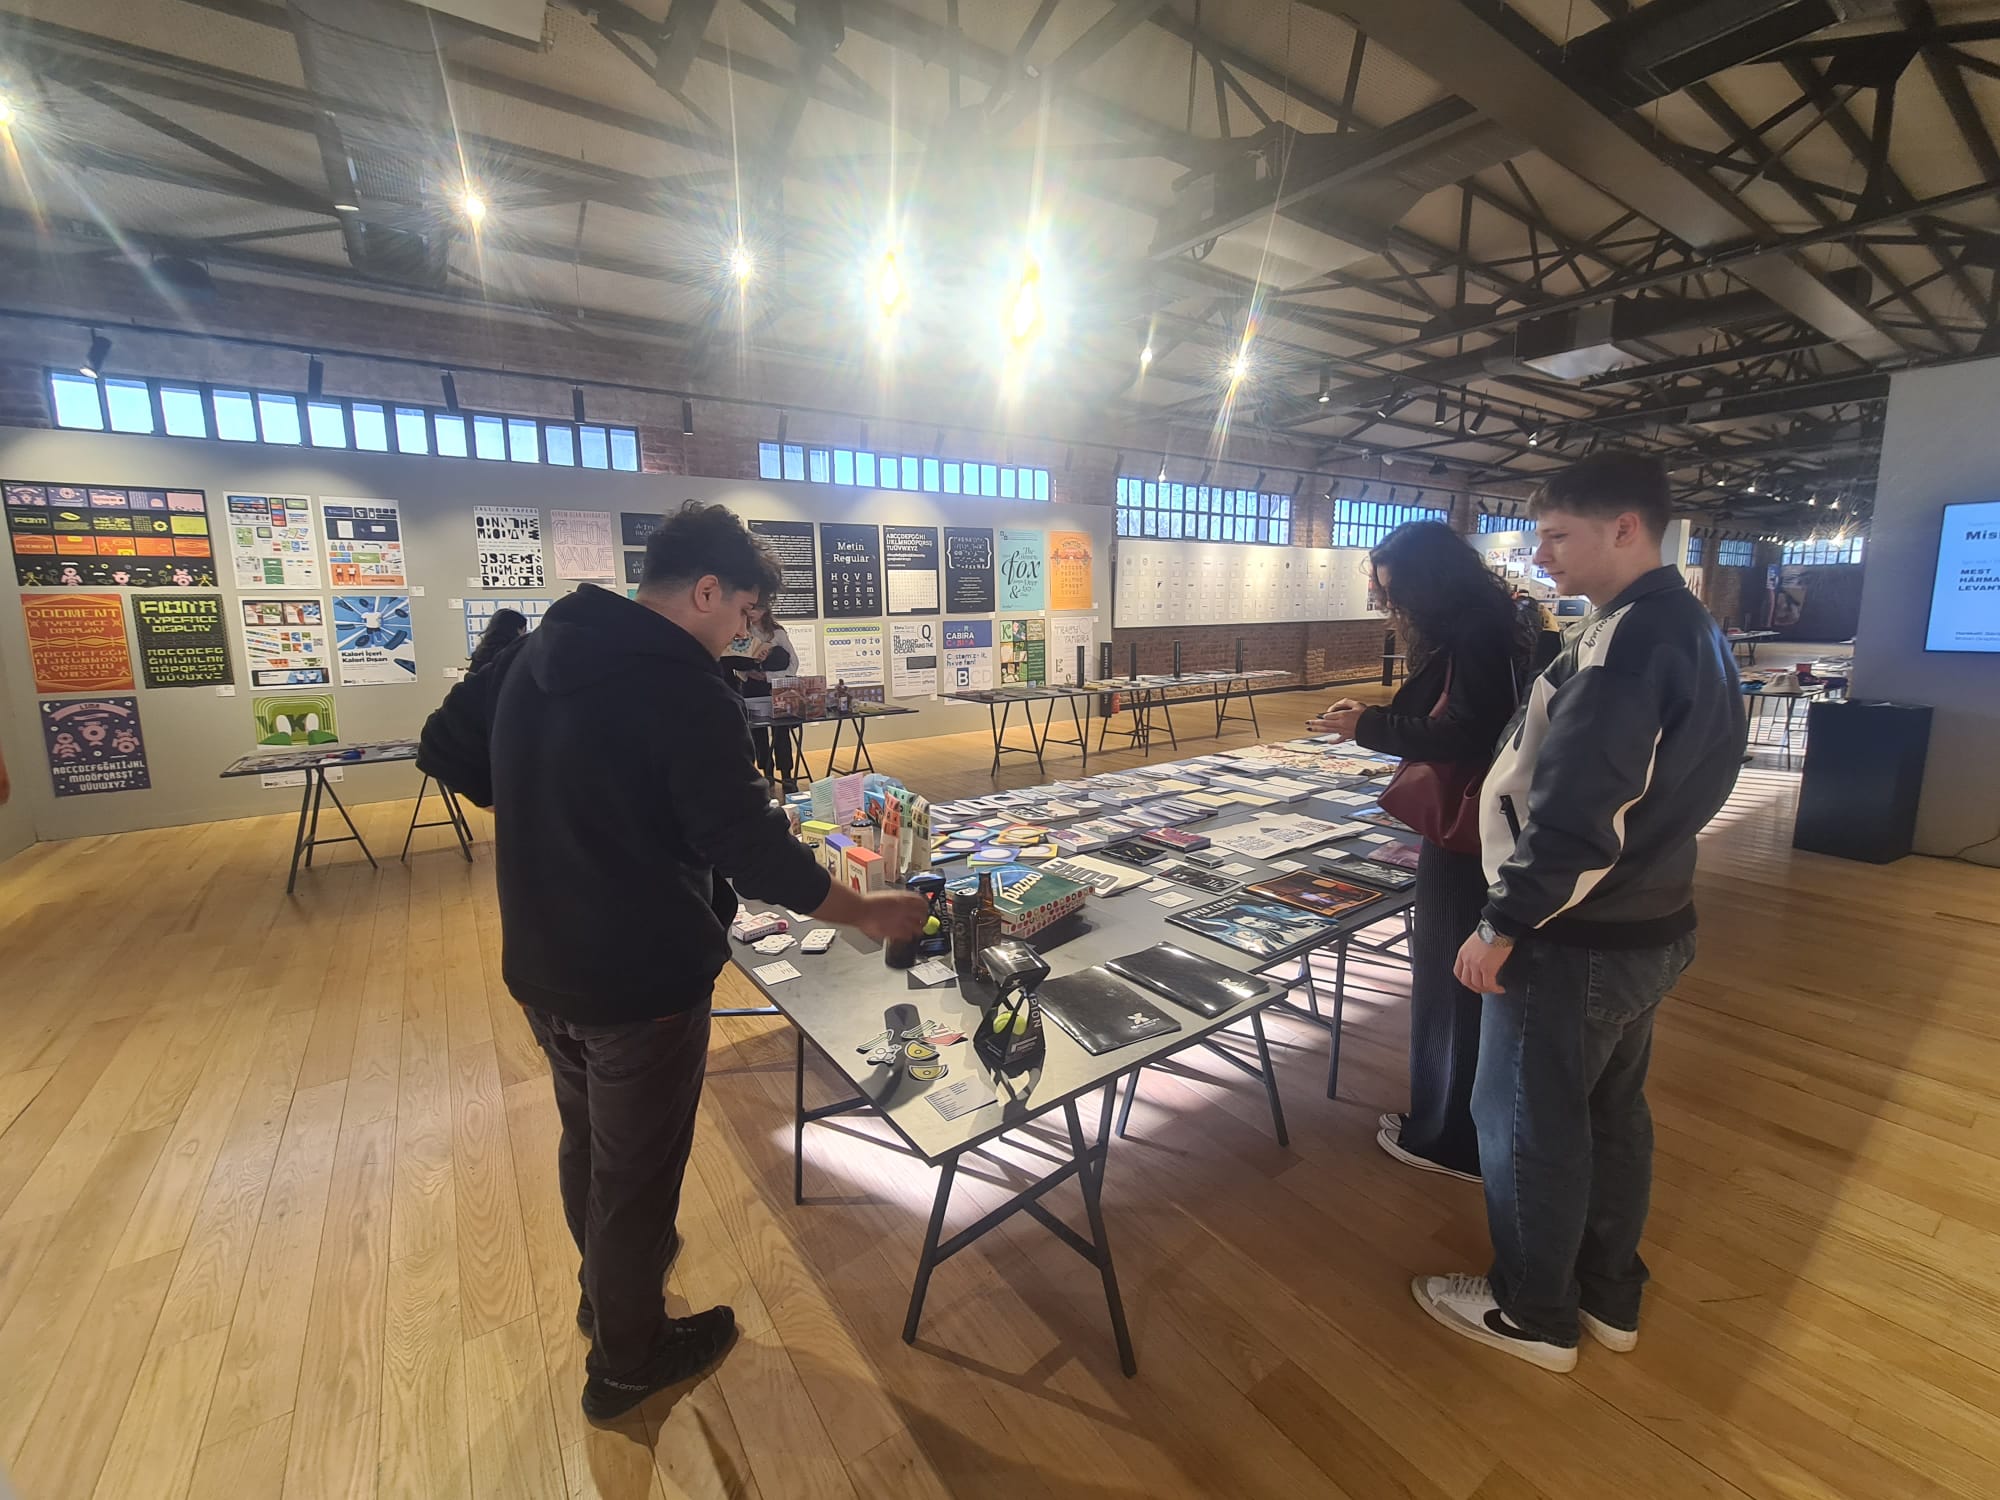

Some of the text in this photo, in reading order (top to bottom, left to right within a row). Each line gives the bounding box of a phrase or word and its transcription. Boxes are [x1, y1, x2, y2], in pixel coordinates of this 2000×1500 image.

[837, 541, 864, 551] Metin
[832, 553, 870, 564] Regular
[1001, 550, 1041, 585] fox
[28, 608, 119, 618] ODDMENT
[921, 624, 932, 642] Q
[1001, 872, 1043, 905] pizza
